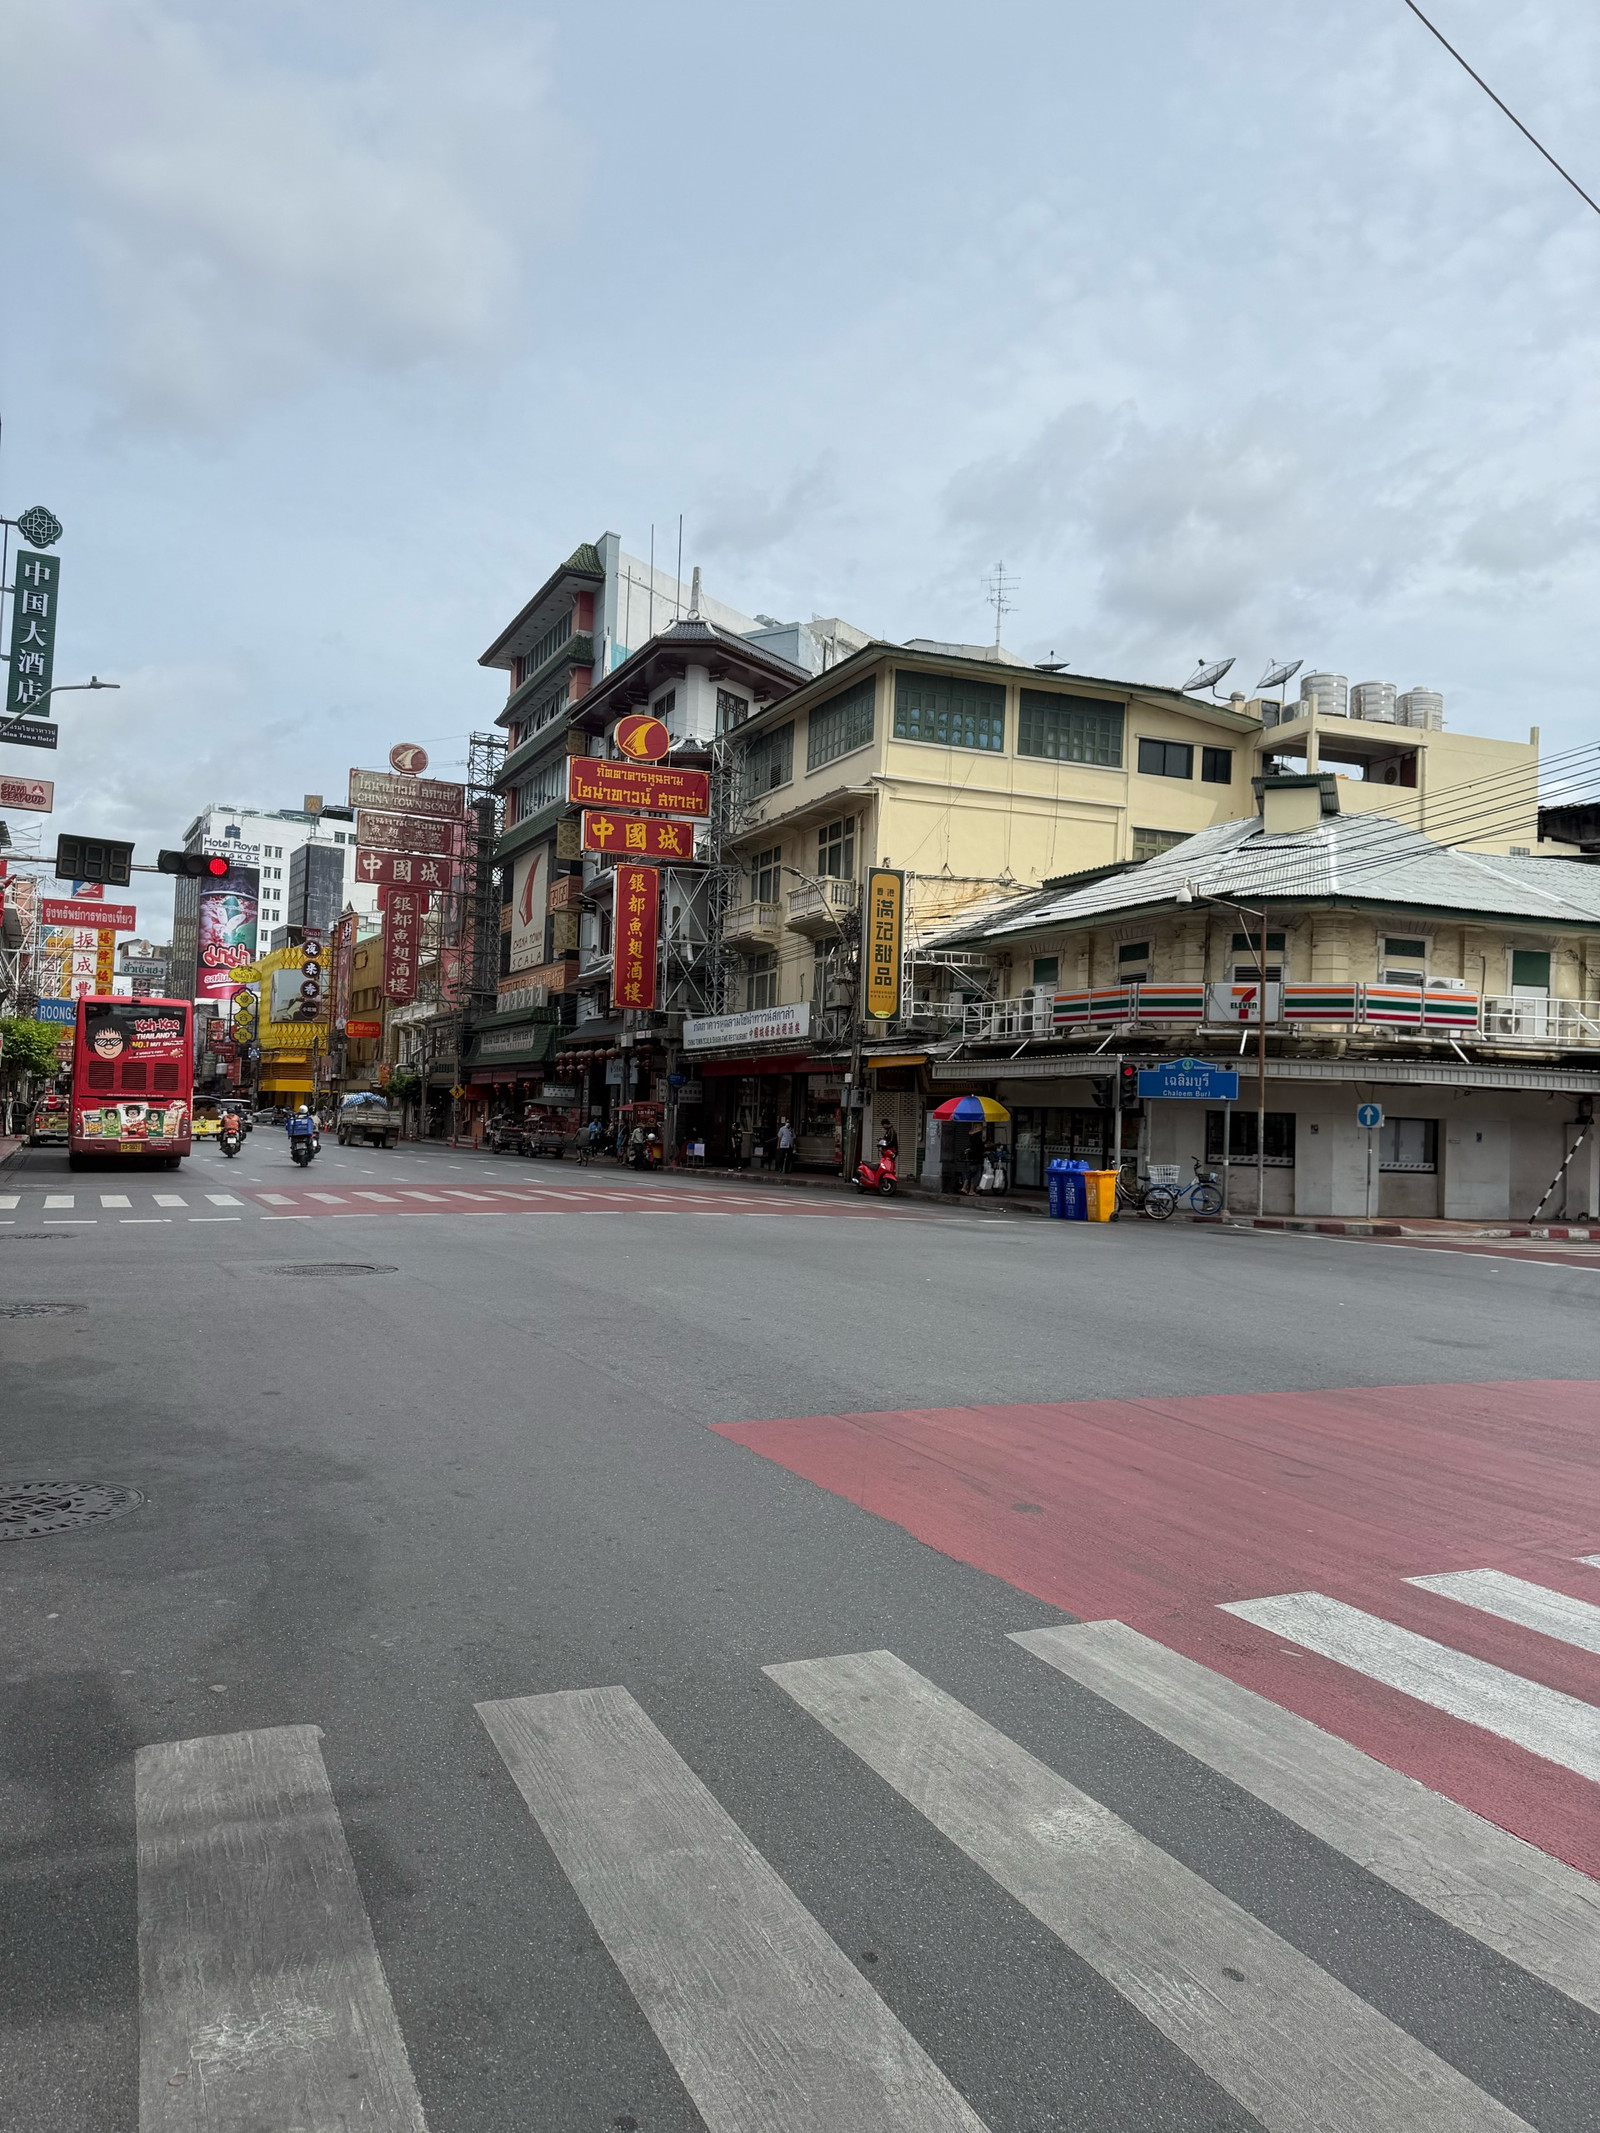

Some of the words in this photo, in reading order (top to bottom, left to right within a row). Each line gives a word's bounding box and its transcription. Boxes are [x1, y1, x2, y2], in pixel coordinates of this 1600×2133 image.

[16, 561, 50, 705] 中国大酒店
[37, 735, 55, 743] Hotel
[1, 783, 26, 796] SIAM
[575, 776, 652, 806] ไชน่าทาวน์
[658, 791, 704, 811] สกาล่า
[357, 792, 388, 804] CHINA
[393, 797, 422, 809] TOWN
[424, 801, 457, 813] SCALA
[204, 837, 230, 848] Hotel
[234, 841, 260, 852] Royal
[592, 816, 682, 855] 中國城
[362, 853, 442, 887] 中國城
[45, 903, 133, 925] รุ่งทรัพย์การท่องเที่ยว
[388, 896, 414, 994] 銀都魚翅酒樓
[513, 935, 528, 951] CHINA
[624, 873, 647, 1004] 銀都魚翅酒樓
[512, 951, 542, 970] SCALA
[135, 1018, 180, 1032] Koh-Kae
[136, 1032, 177, 1040] THAILAND'S
[1164, 1073, 1210, 1091] เฉลิมบุรี
[1163, 1089, 1193, 1097] Chaloem
